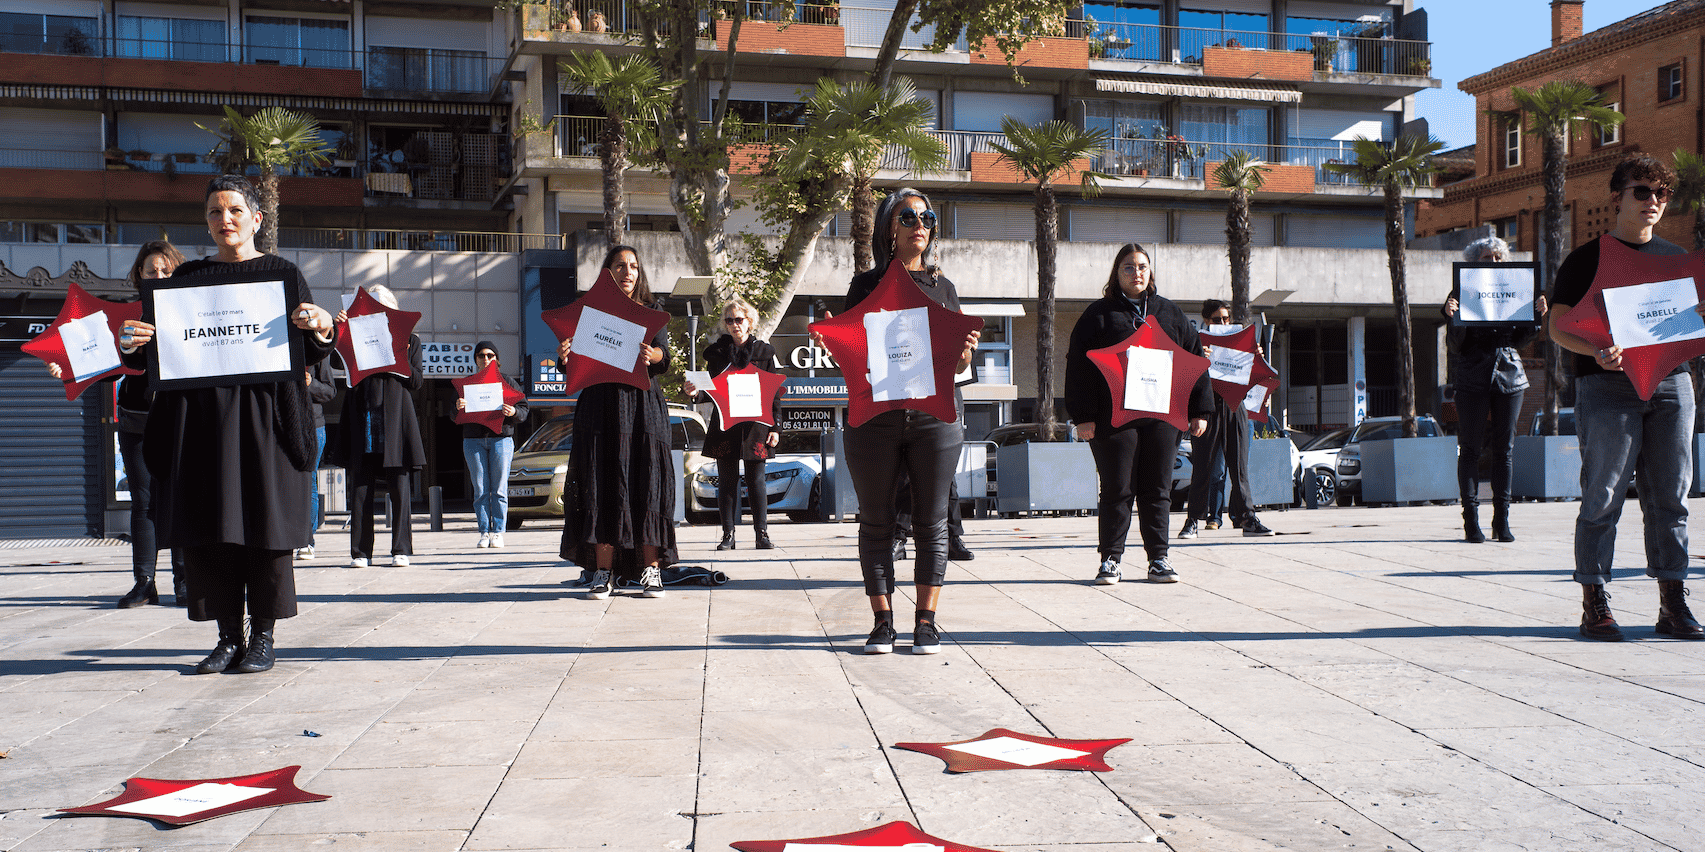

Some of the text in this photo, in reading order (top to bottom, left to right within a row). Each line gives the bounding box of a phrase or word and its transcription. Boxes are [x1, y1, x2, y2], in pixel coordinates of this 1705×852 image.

[1637, 307, 1678, 319] ISABELLE
[28, 323, 51, 334] FD
[183, 324, 260, 341] JEANNETTE
[594, 332, 623, 347] AURÉLIE
[421, 344, 473, 352] FABIO
[790, 345, 841, 369] GR
[888, 351, 913, 360] LOUIZA
[788, 411, 831, 420] LOCATION
